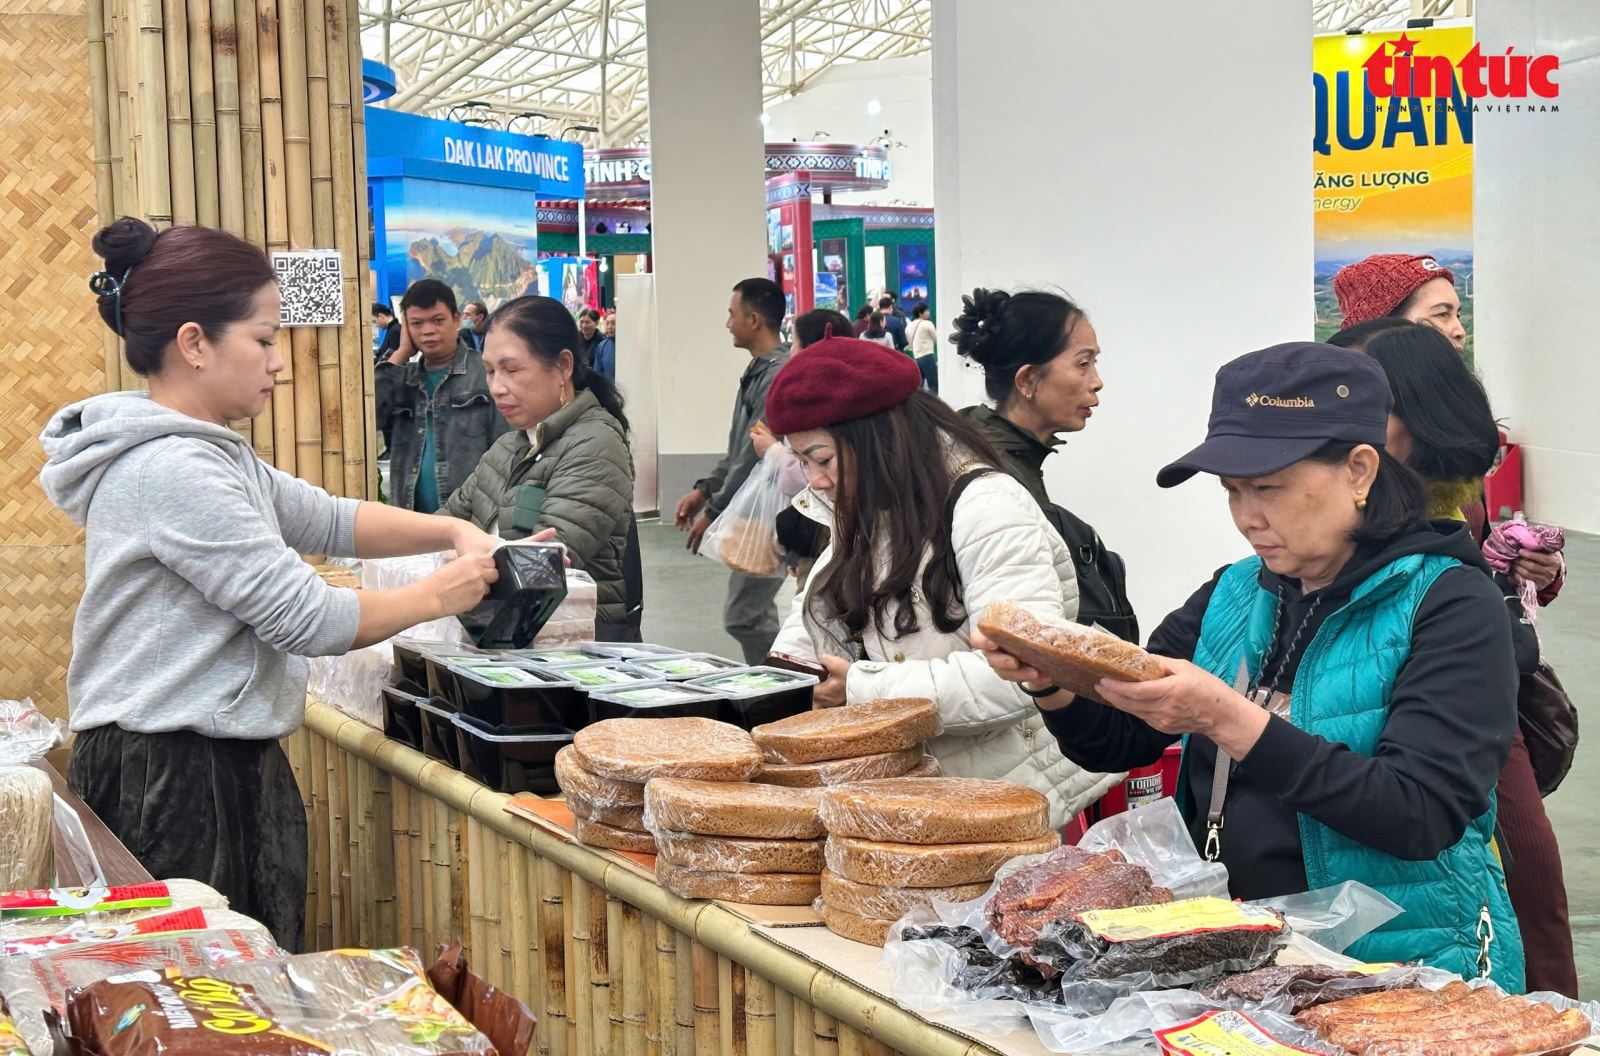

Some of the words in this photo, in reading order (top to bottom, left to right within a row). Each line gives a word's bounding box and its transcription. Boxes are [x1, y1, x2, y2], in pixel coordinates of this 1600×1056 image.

[444, 137, 476, 167] DAK
[476, 142, 505, 171] LAK
[505, 147, 570, 182] PROVINCE
[1361, 171, 1429, 189] LƯỢNG
[1260, 395, 1316, 408] Columbia
